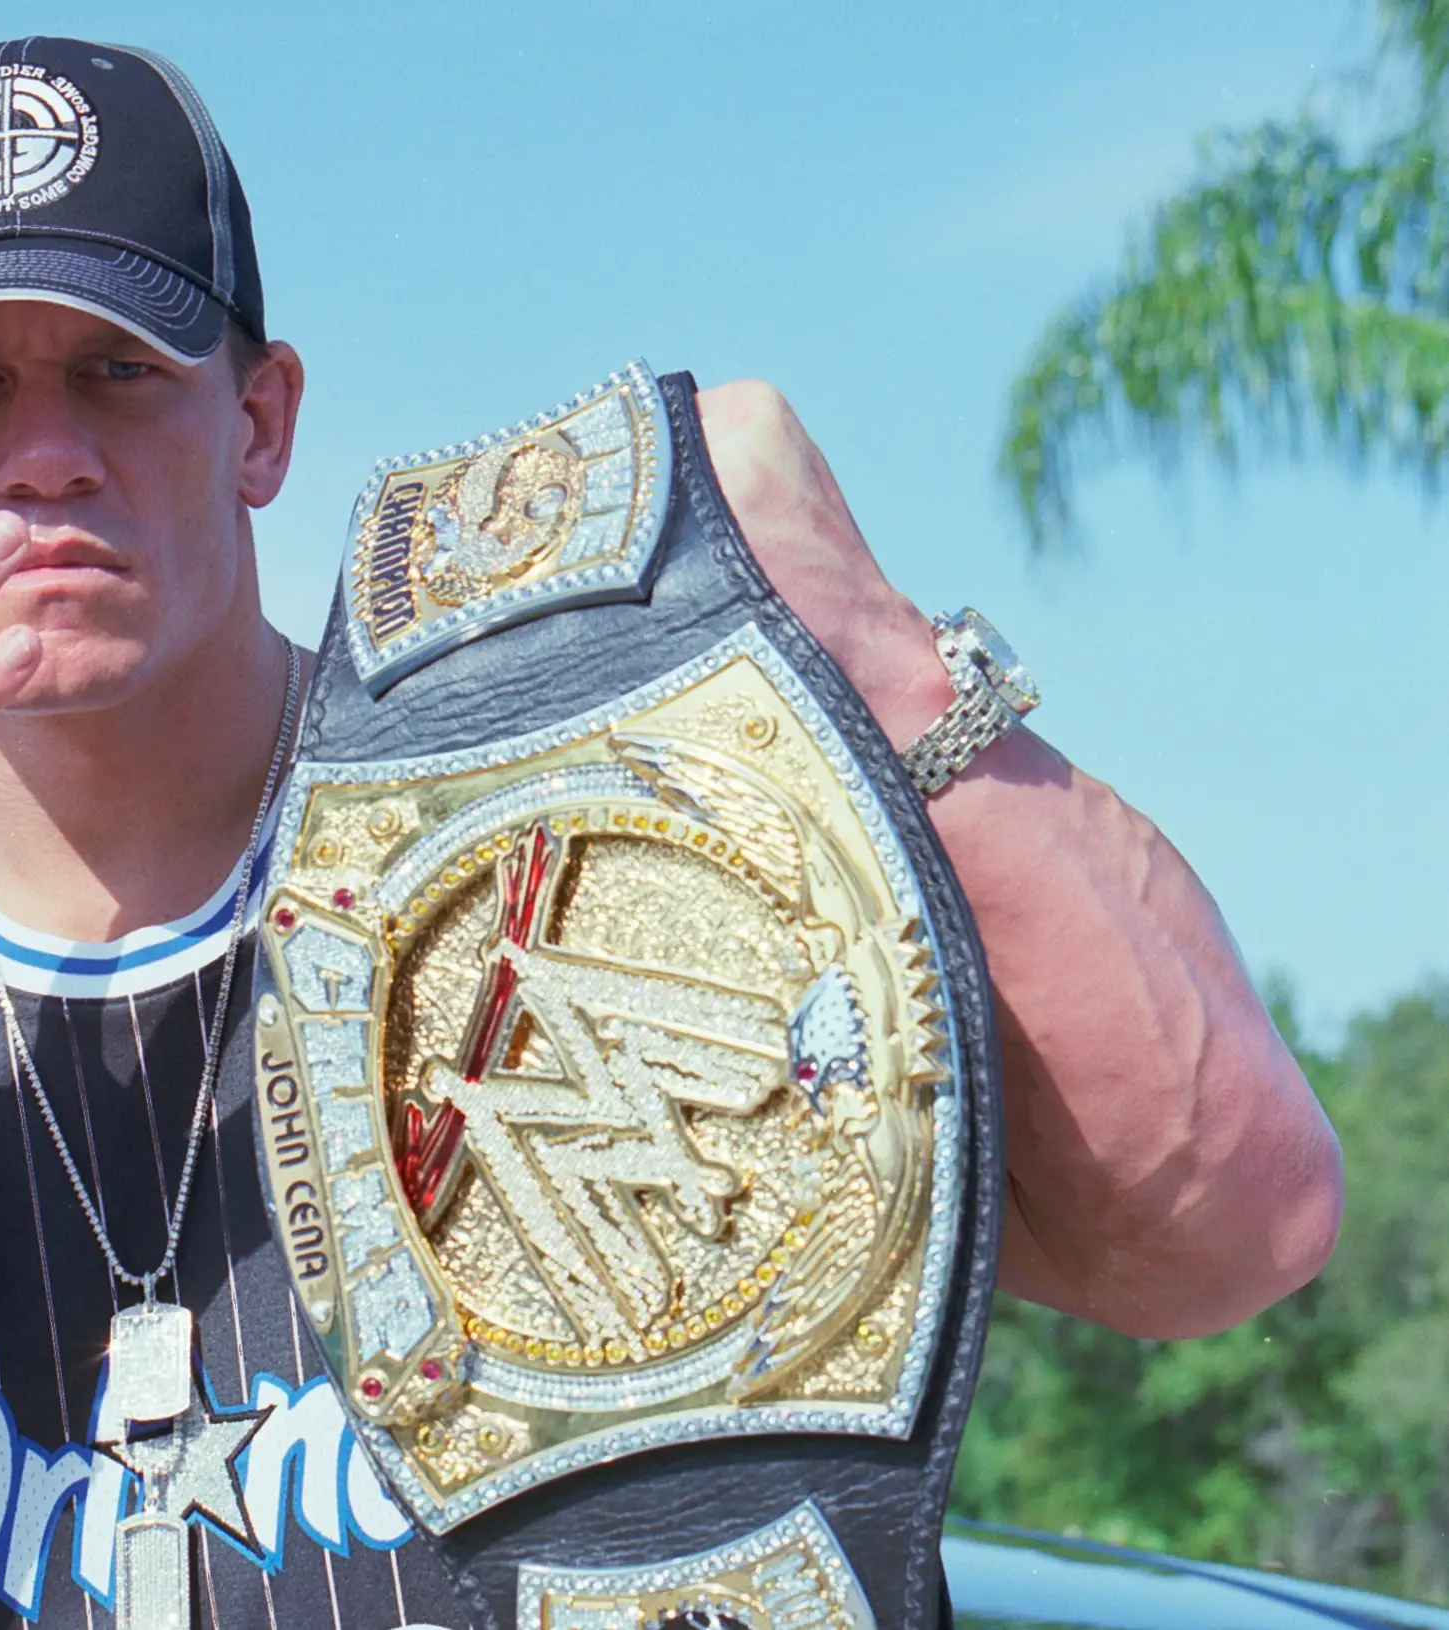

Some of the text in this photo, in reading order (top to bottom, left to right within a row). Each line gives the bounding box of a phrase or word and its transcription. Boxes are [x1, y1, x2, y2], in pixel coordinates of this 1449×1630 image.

[18, 180, 68, 210] SOME
[50, 75, 91, 115] SOME
[371, 481, 425, 638] CHAMPION
[261, 1051, 329, 1281] JOHN CENA
